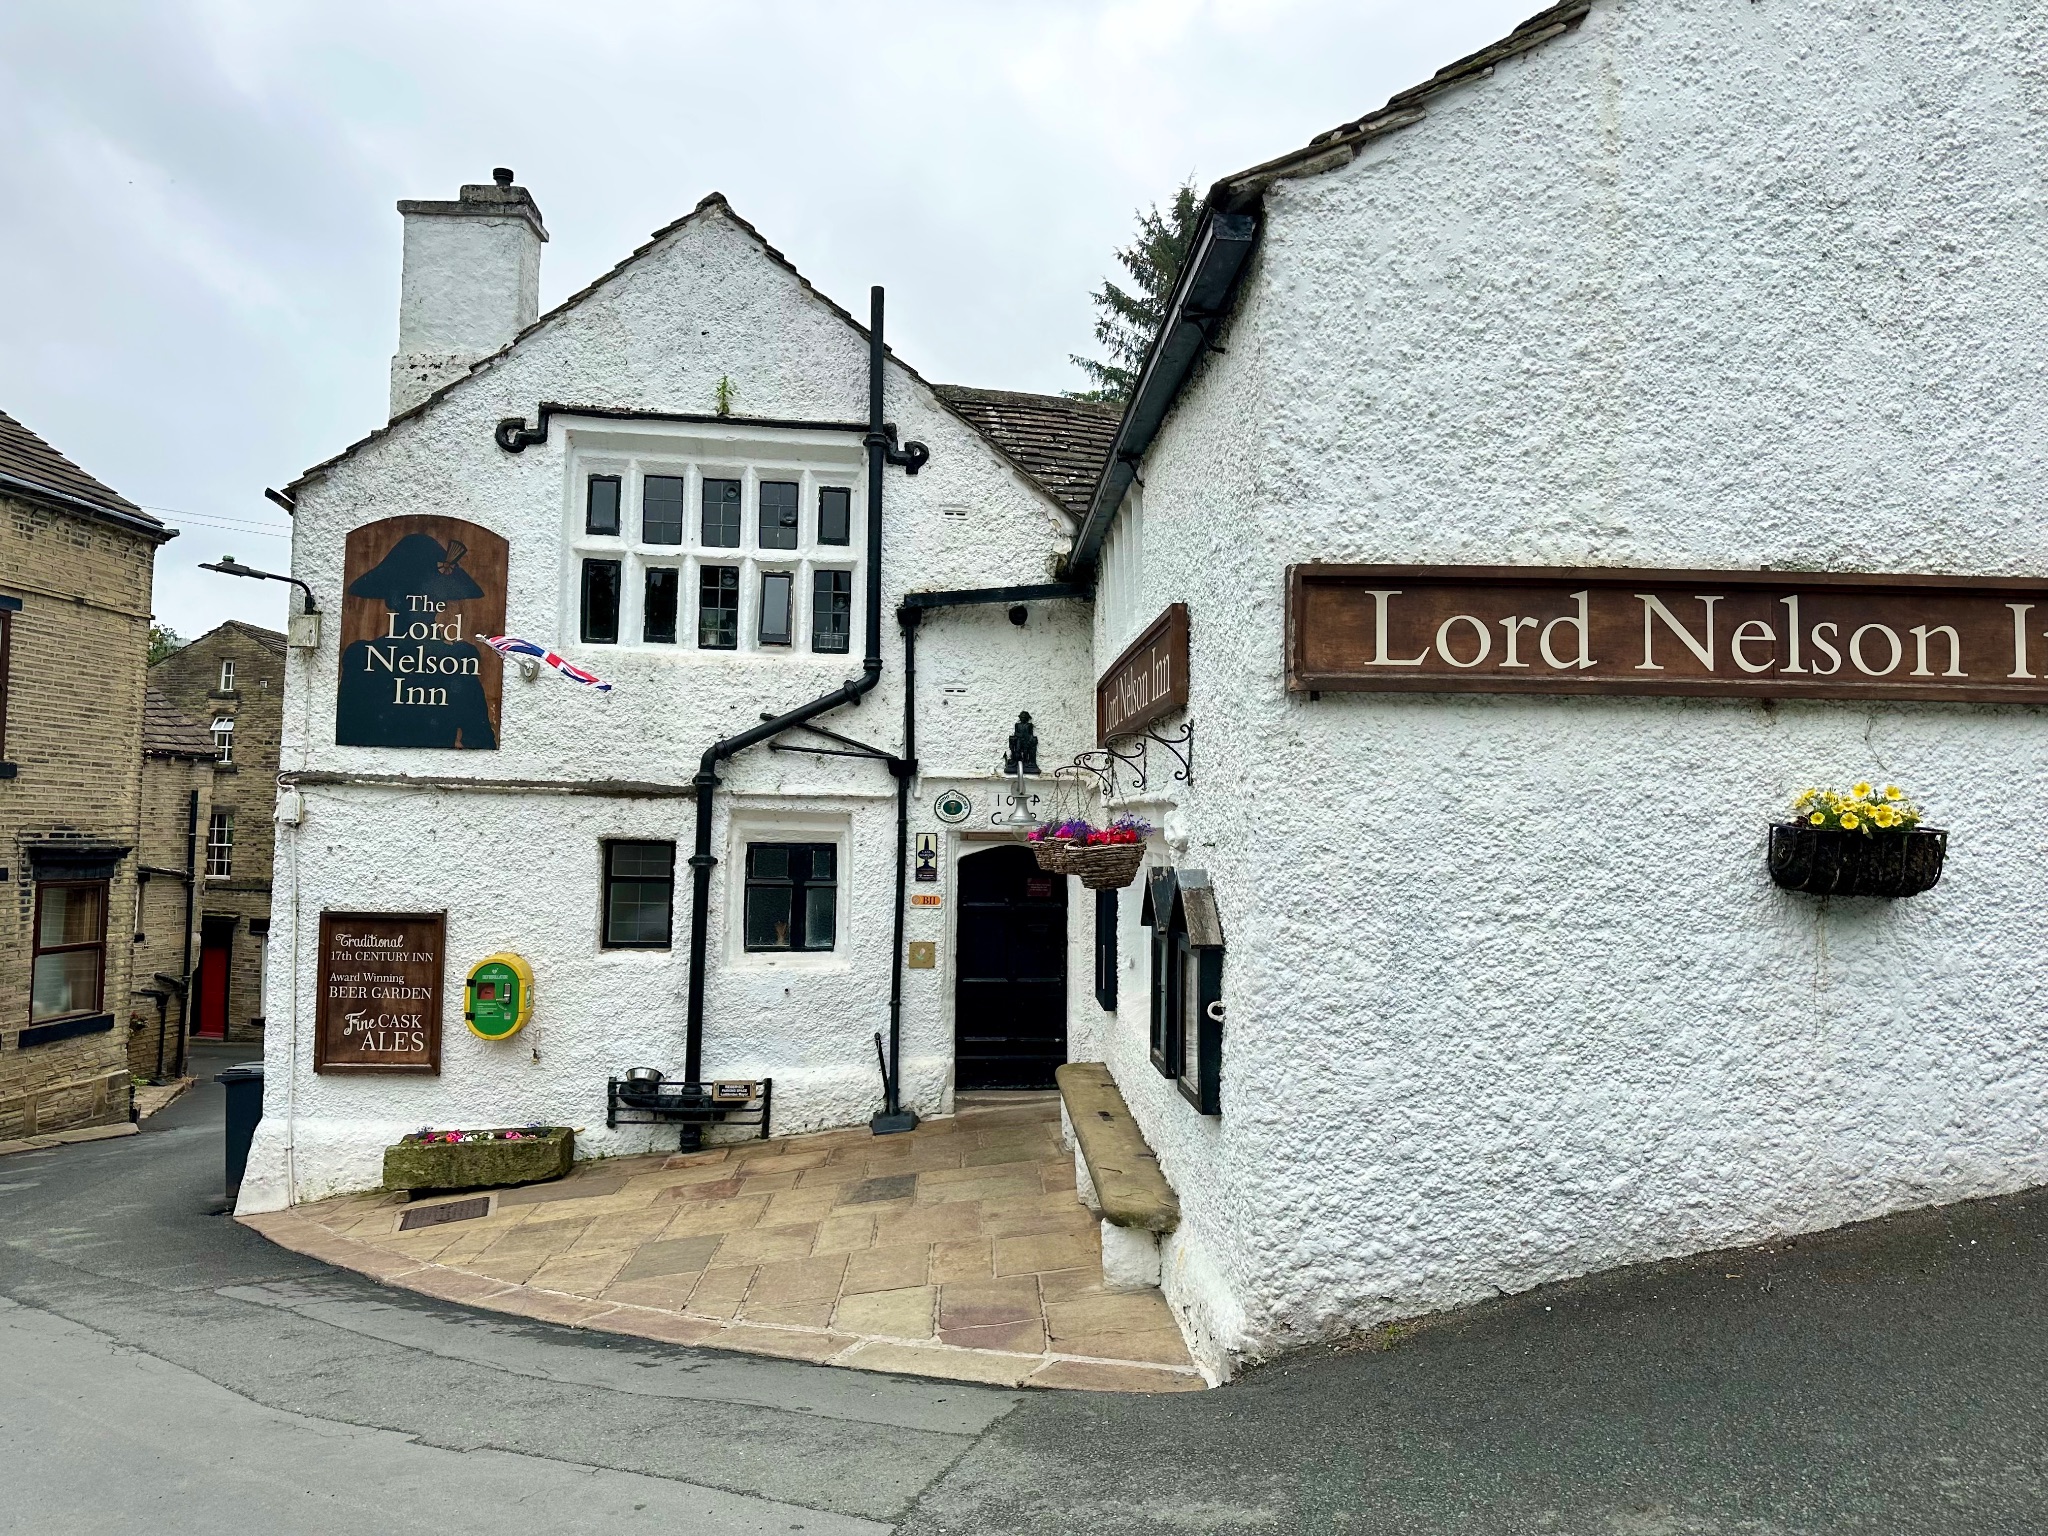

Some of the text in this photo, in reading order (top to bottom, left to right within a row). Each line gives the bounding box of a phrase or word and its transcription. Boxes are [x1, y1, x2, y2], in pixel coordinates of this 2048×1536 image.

[406, 595, 446, 613] The
[385, 612, 463, 641] Lord
[1364, 590, 2048, 678] Lord Nelson I
[364, 645, 481, 675] Nelson
[393, 678, 449, 706] Inn
[1105, 647, 1170, 733] Lord Nelson Inn
[335, 933, 404, 948] Traditional
[331, 951, 434, 962] 17th CENTURY INN
[329, 972, 405, 985] Award Winning
[329, 986, 433, 1000] BEER GARDEN
[343, 1008, 422, 1036] Fine CASK
[360, 1031, 424, 1052] ALES
